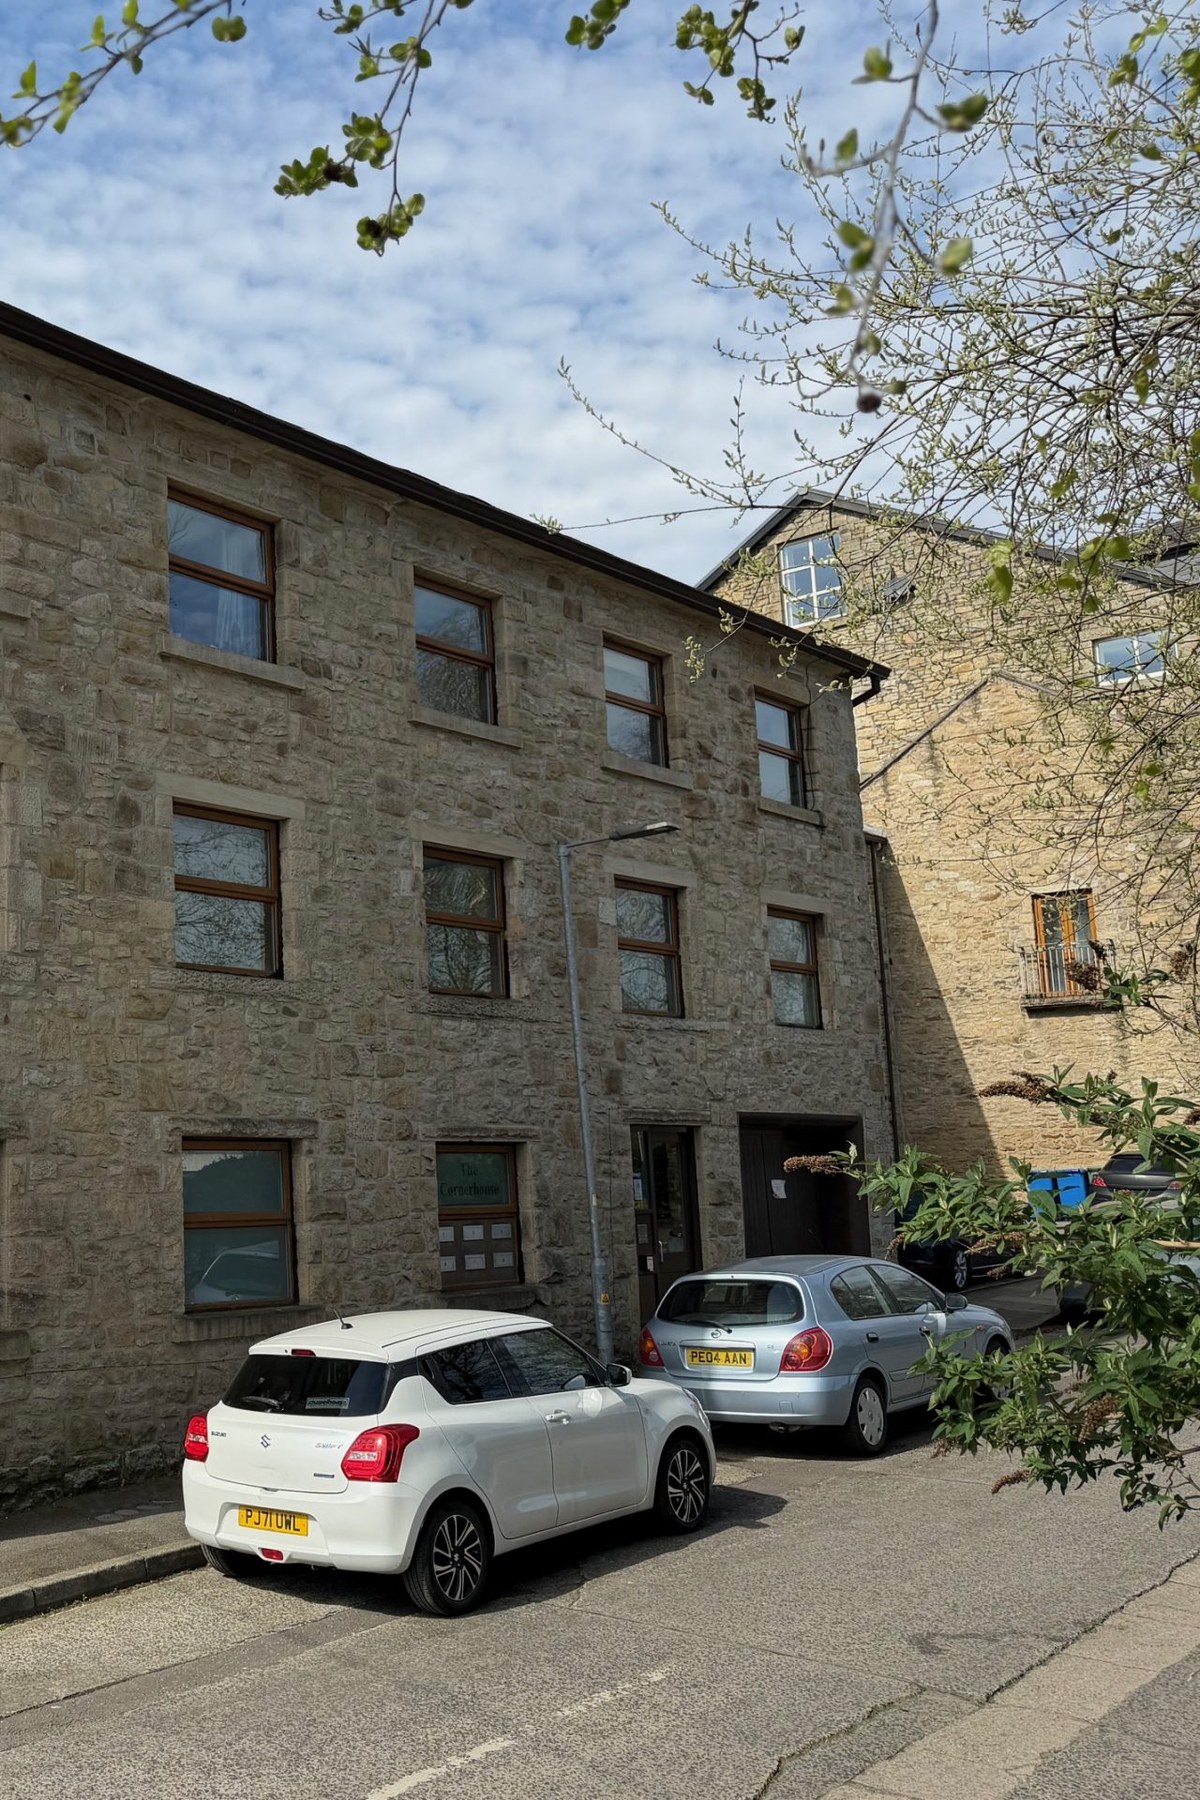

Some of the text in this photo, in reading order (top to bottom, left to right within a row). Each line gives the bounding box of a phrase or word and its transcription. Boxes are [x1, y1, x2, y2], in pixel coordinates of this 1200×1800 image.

[461, 1162, 479, 1177] The
[440, 1182, 499, 1197] Cornerhouse
[691, 1351, 747, 1364] PE04 AAN
[246, 1509, 301, 1532] PJ71 UWL
